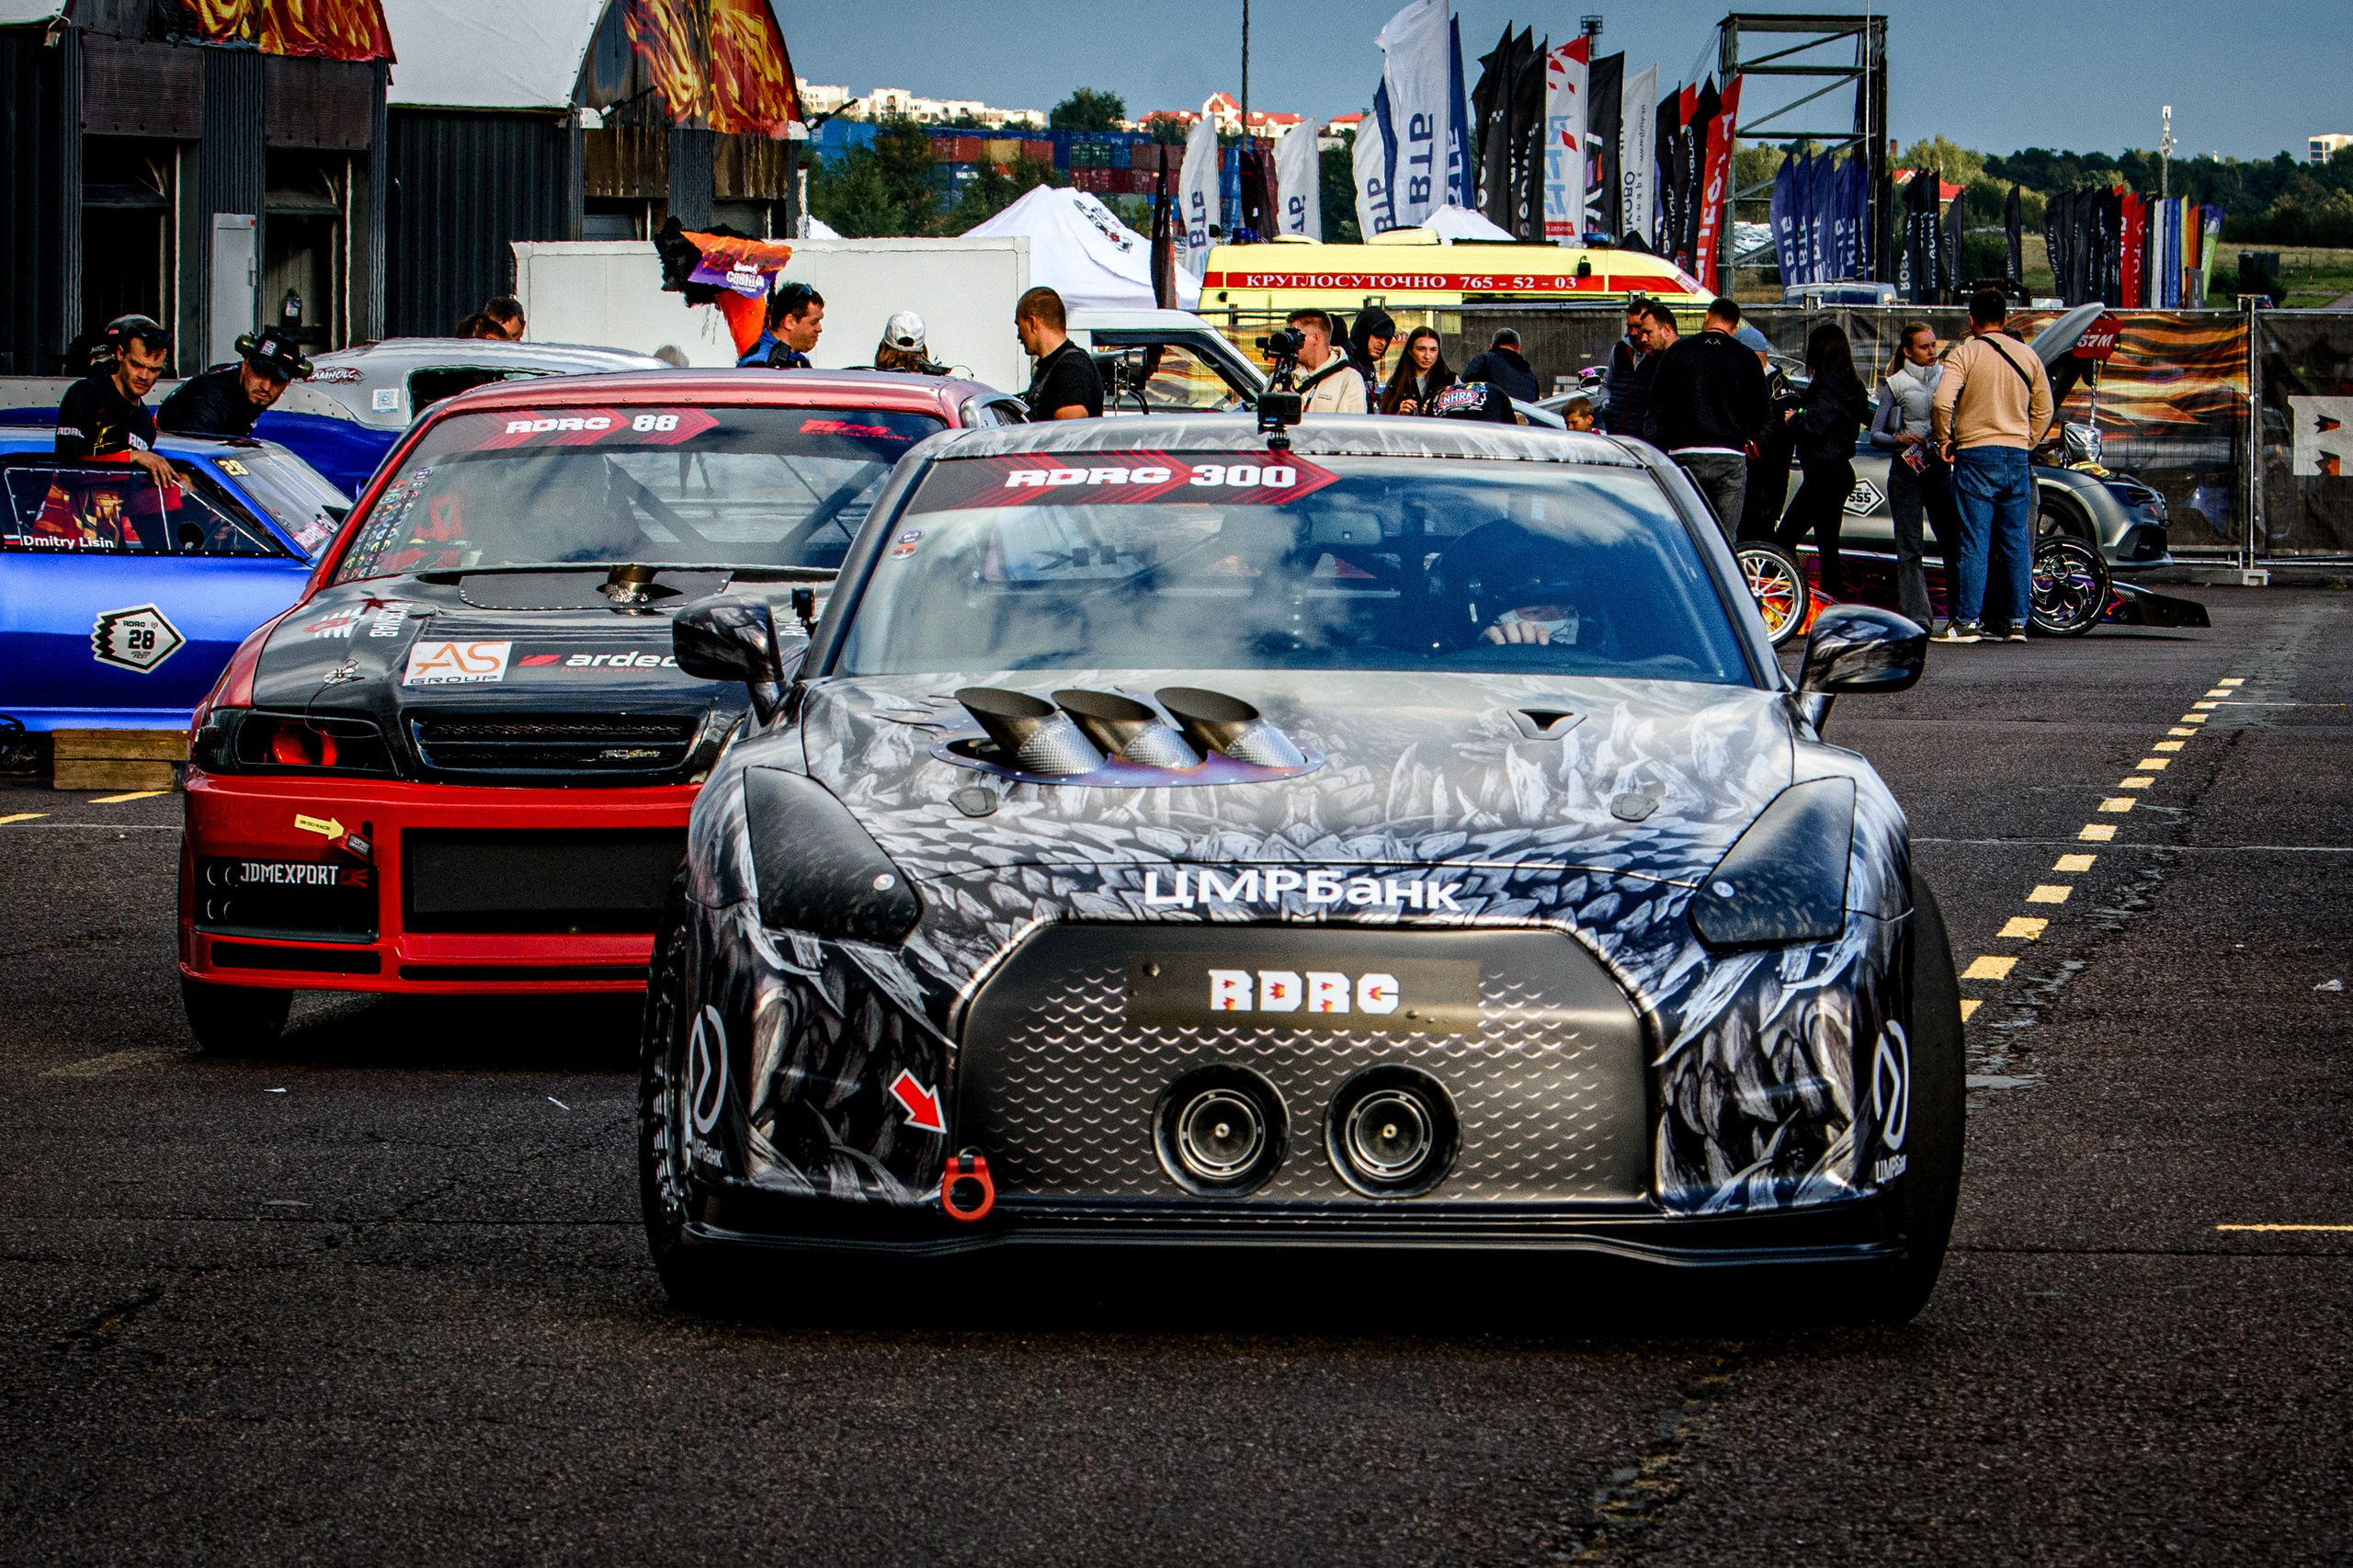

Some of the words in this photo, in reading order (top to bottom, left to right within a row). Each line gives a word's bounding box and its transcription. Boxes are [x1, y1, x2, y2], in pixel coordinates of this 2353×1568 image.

[1245, 275, 1447, 290] КРУГЛОСУТОЧНО
[1460, 277, 1494, 290] 765
[1513, 277, 1535, 290] 52
[1554, 277, 1577, 290] 03
[2076, 334, 2114, 347] 57M
[1443, 392, 1473, 403] NHRA
[506, 416, 611, 435] RDRC
[631, 415, 679, 432] 88
[1005, 467, 1171, 487] RDRC
[1189, 465, 1297, 488] 300
[23, 535, 75, 550] Dmitry
[79, 536, 114, 549] Lisin
[128, 629, 155, 650] 28
[415, 642, 506, 676] AS
[410, 675, 498, 685] GROUP
[240, 862, 339, 885] JDMEXPORT
[1144, 869, 1462, 912] ЦМРБанк
[1208, 969, 1399, 1015] RDRC
